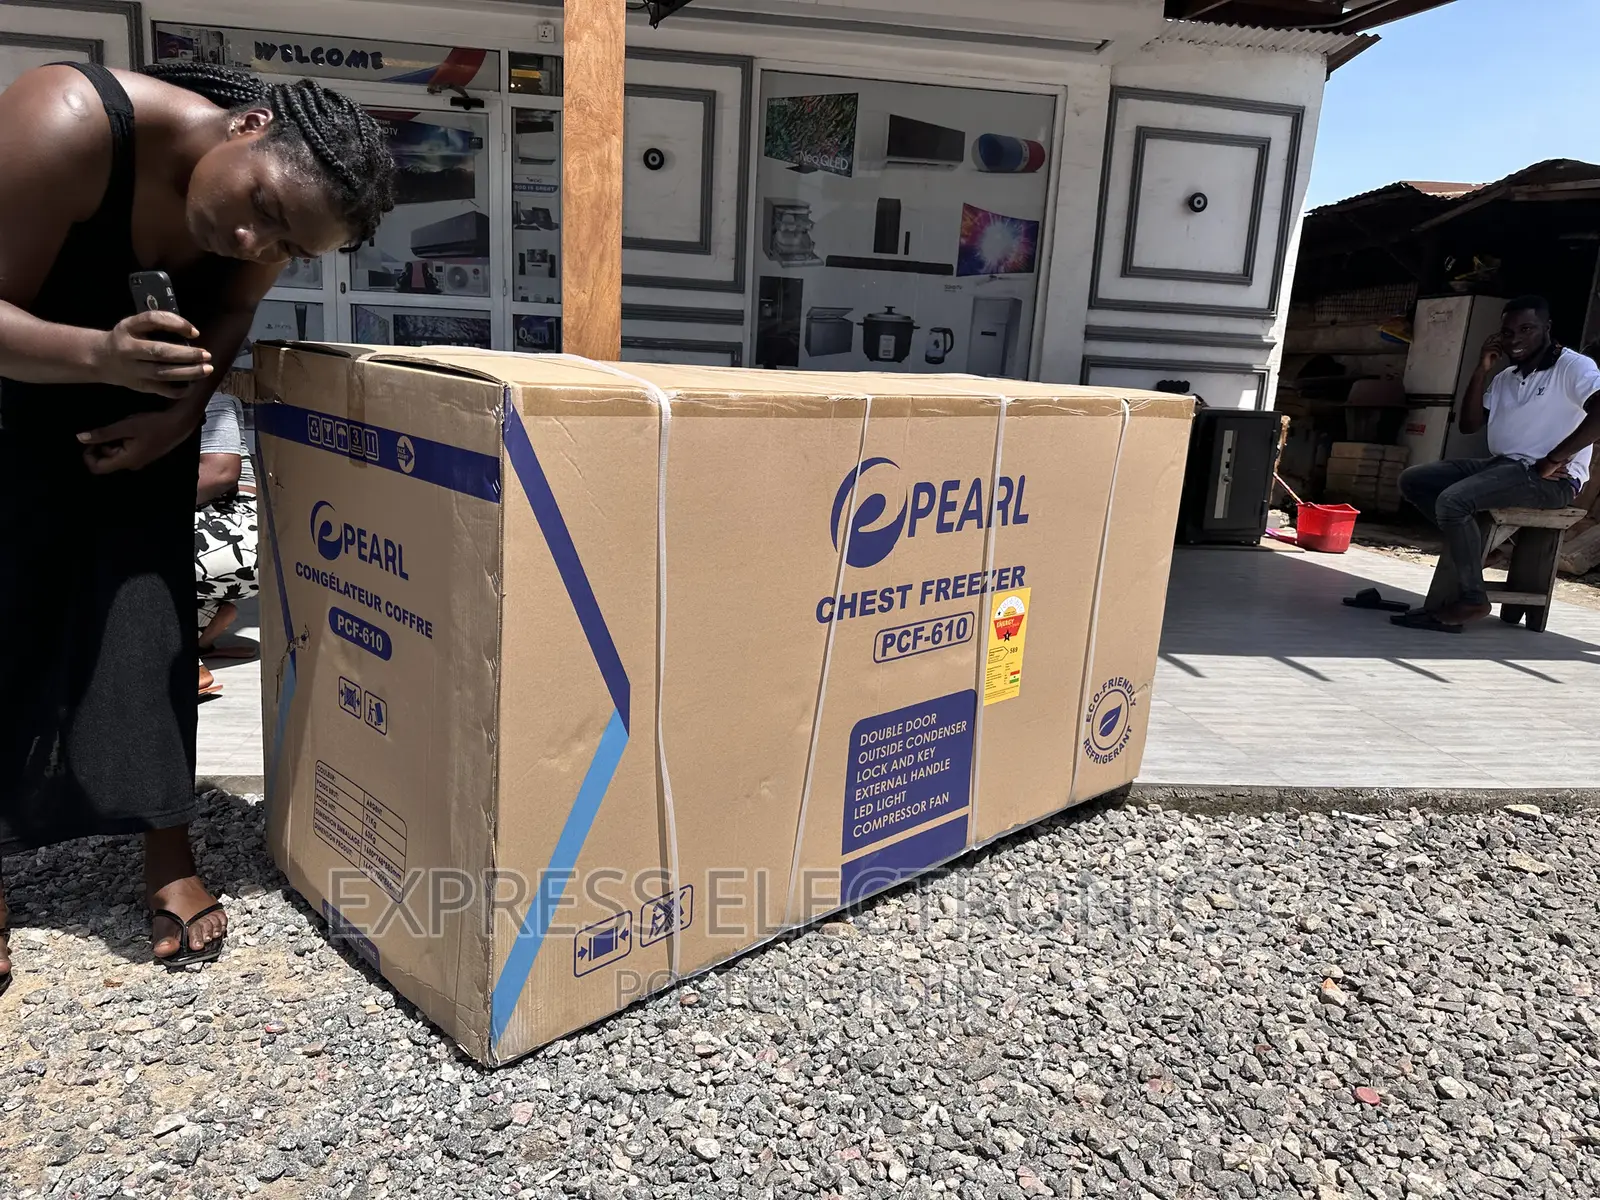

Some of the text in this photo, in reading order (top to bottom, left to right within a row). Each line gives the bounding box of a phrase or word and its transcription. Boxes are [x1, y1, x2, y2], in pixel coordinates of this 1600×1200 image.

[254, 41, 384, 70] WELCOME
[820, 154, 849, 170] QLED
[907, 475, 1029, 538] PEARL
[344, 522, 409, 581] PEARL
[295, 562, 433, 640] CONGÉLATEUR COFFRE
[815, 565, 1026, 624] CHEST FREEZER
[337, 613, 383, 652] PCF-610
[880, 616, 968, 657] PCF-610
[1085, 676, 1137, 723] ECO-FRIENDLY
[858, 720, 967, 765] OUTSIDE CONDENSER
[859, 713, 937, 747] DOUBLE DOOR
[1083, 725, 1133, 765] REFRIGERANT
[855, 758, 951, 802] EXTERNAL HANDLE
[856, 746, 937, 784] LOCK AND KEY
[853, 792, 950, 838] COMPRESSOR FAN
[854, 790, 907, 820] LED LIGHT
